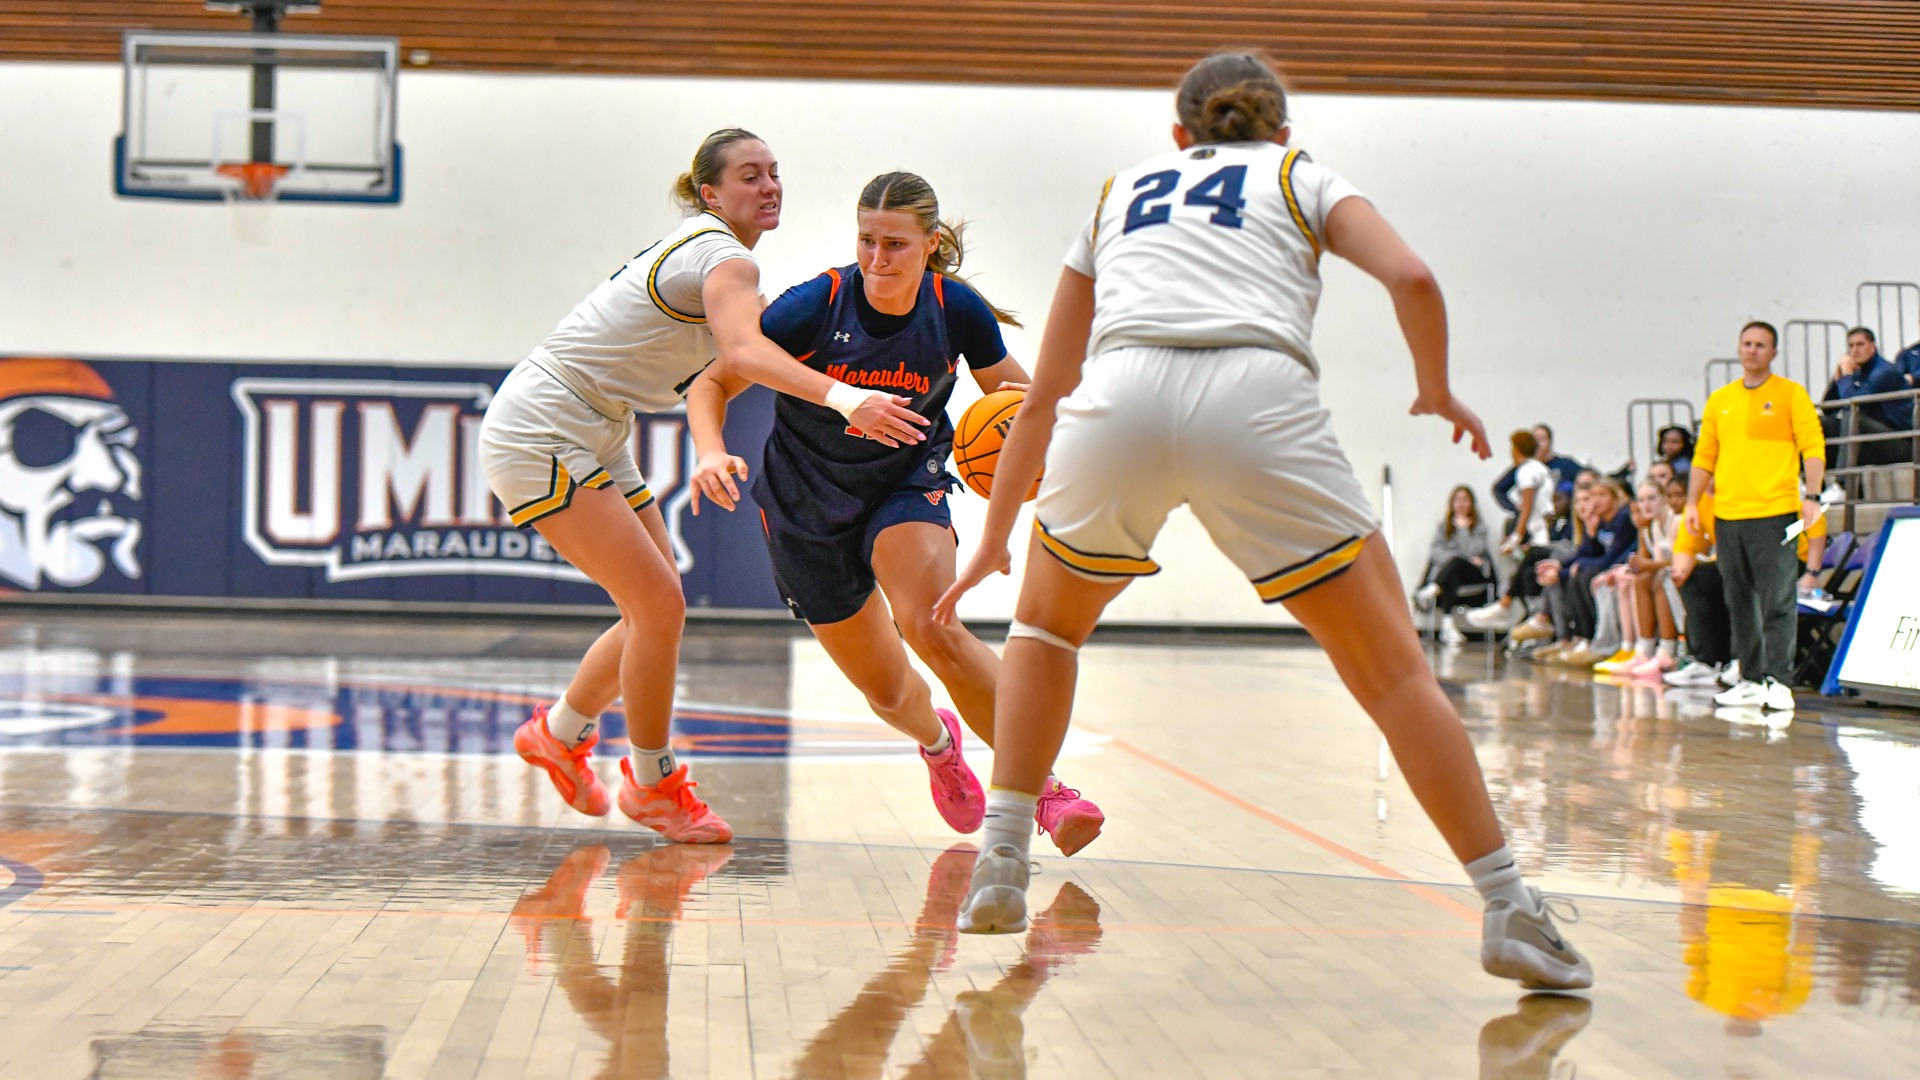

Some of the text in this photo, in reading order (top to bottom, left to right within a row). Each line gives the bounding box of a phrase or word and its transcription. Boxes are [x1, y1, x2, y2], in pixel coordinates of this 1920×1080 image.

[1123, 165, 1248, 235] 24
[825, 361, 930, 394] Marauders
[262, 400, 682, 545] UMY
[351, 530, 564, 562] MARAUDE
